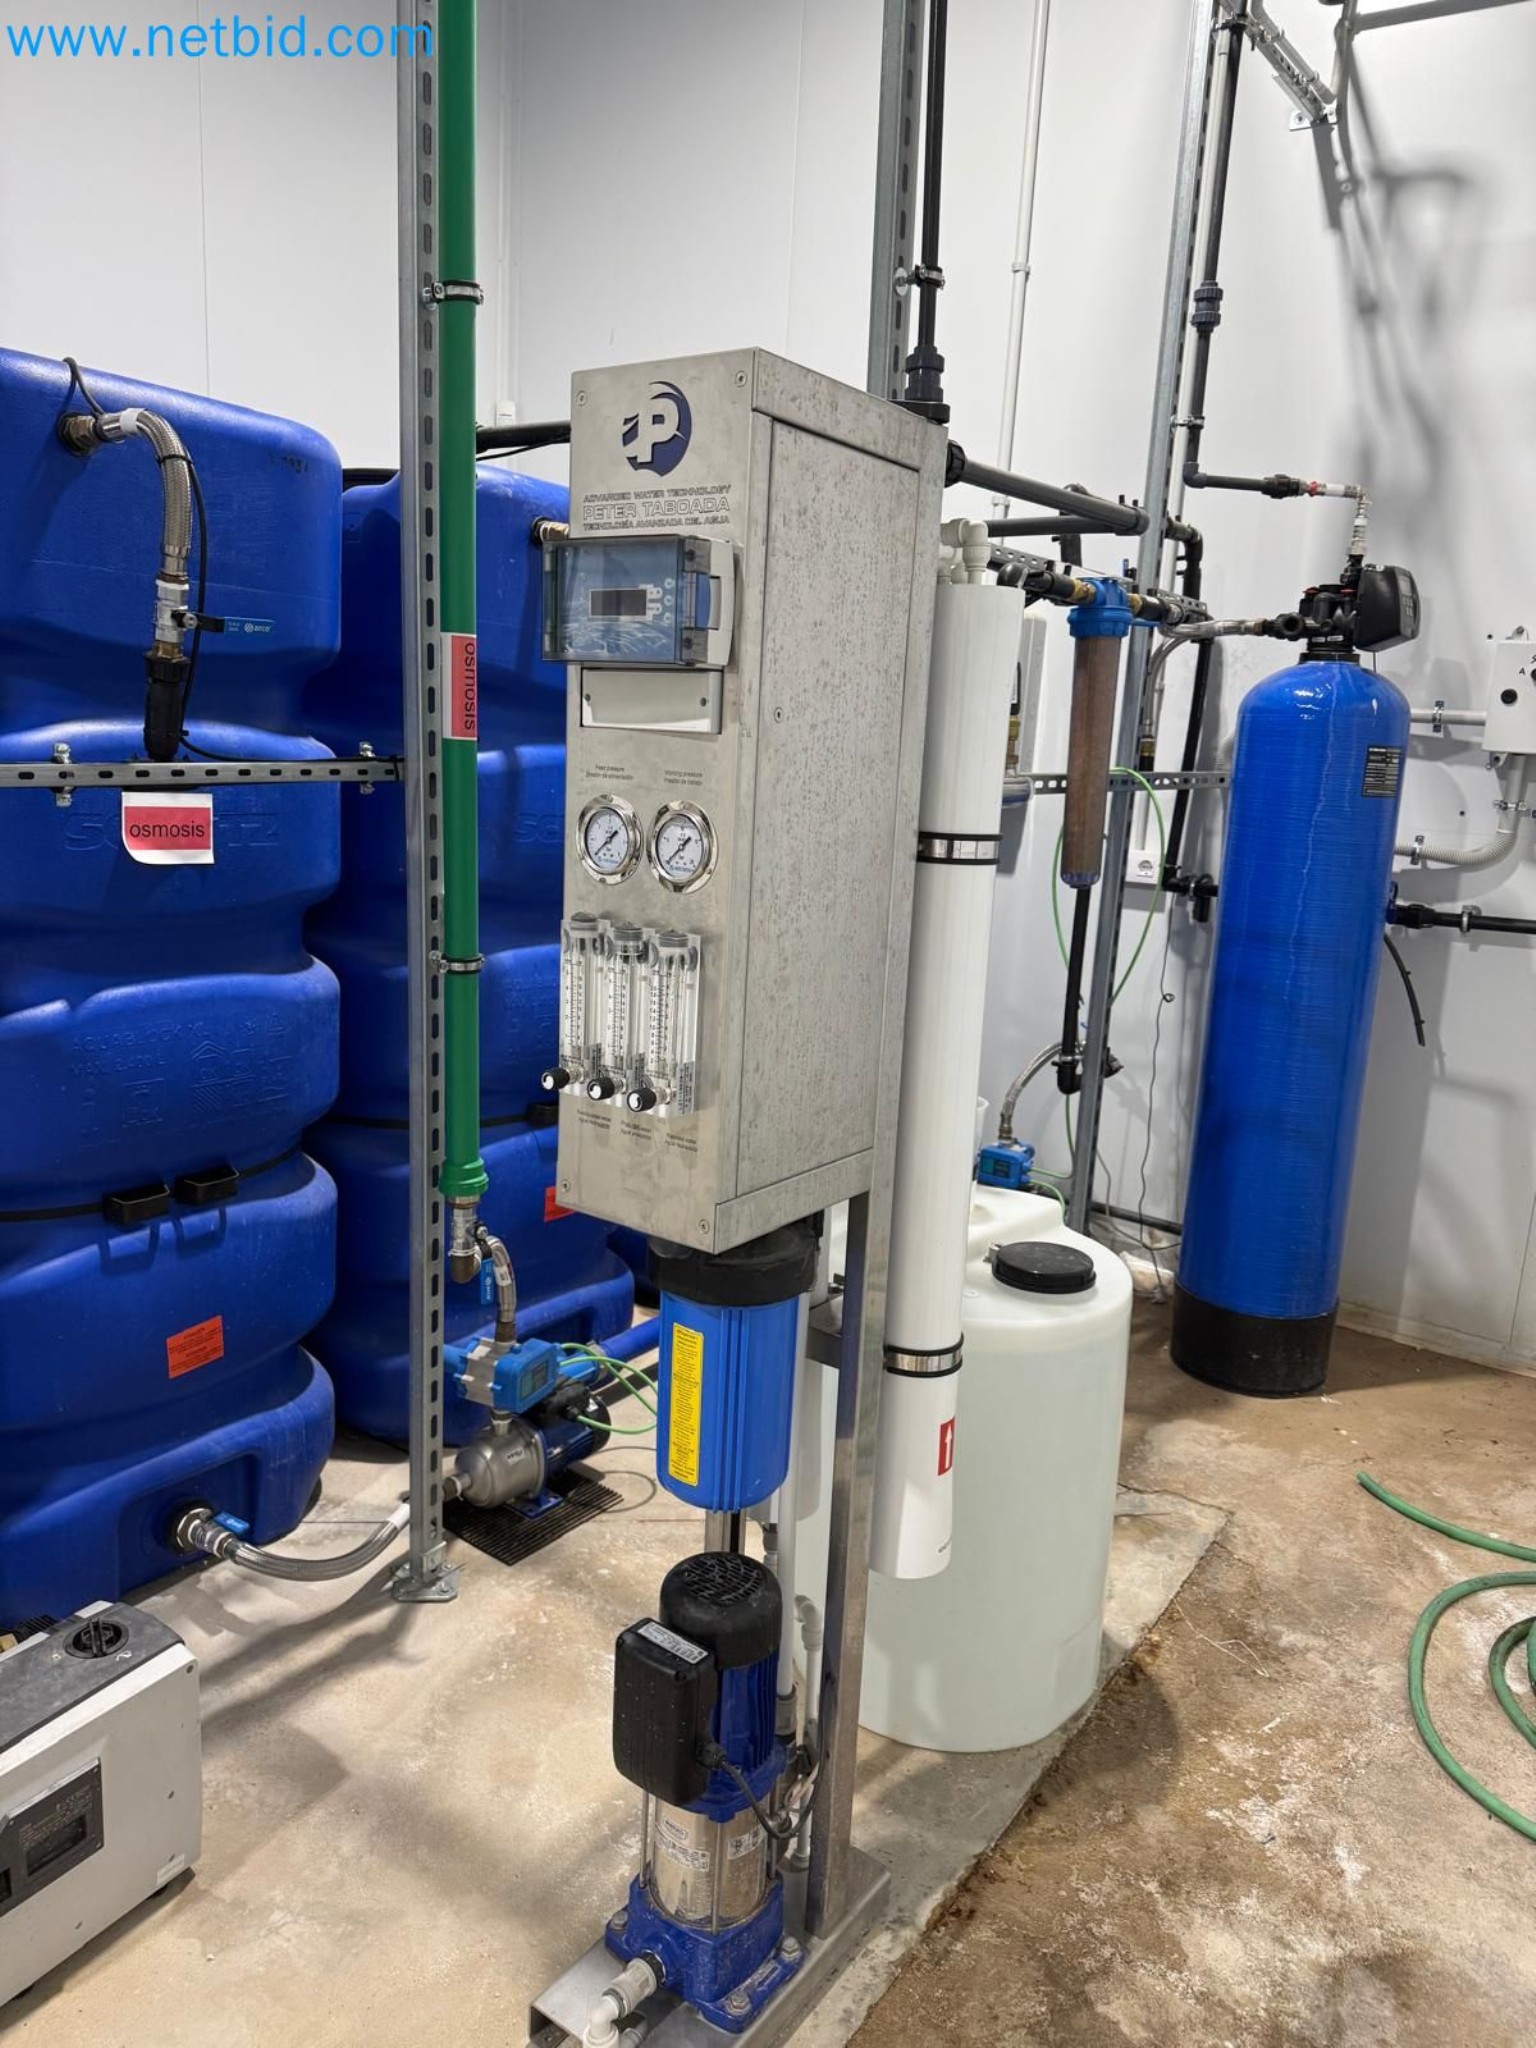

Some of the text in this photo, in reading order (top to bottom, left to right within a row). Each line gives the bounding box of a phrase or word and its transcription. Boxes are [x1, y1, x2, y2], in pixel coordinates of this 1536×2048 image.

[583, 497, 730, 521] PETER TABOADA
[464, 642, 476, 731] osmosis
[129, 820, 205, 839] osmosis
